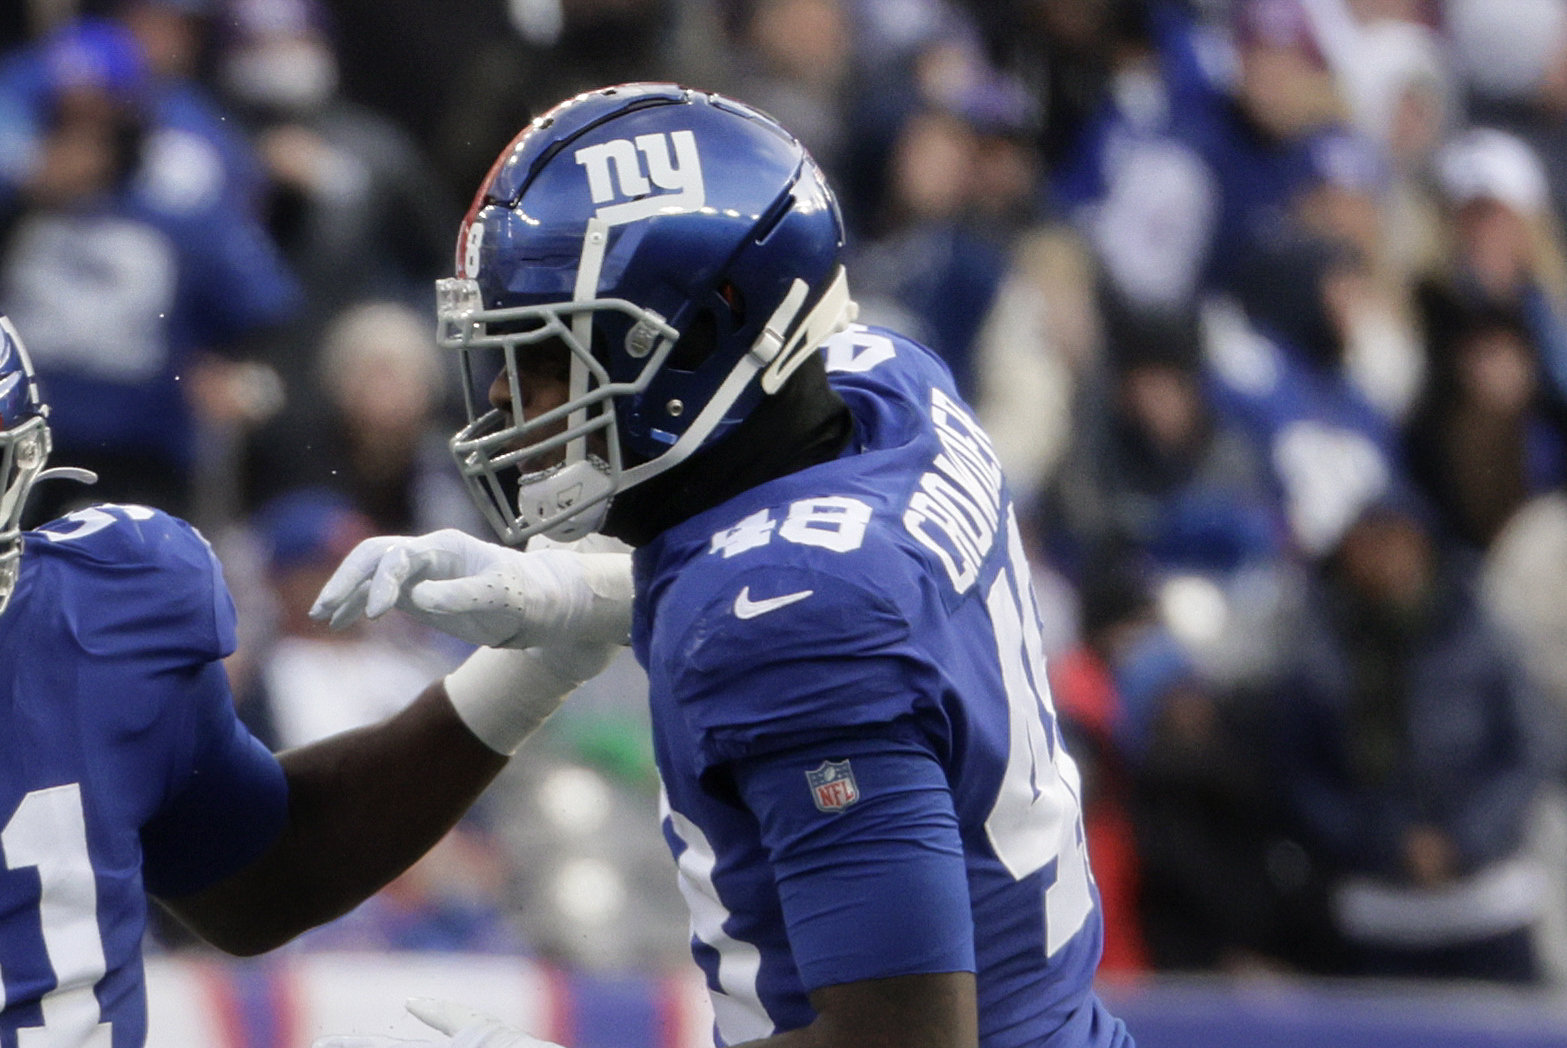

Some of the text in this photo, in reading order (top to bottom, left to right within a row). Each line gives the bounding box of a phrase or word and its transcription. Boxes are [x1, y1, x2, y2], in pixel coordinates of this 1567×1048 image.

[575, 130, 705, 227] ny
[709, 496, 872, 559] 48
[903, 387, 1003, 595] CROWDER
[818, 782, 854, 807] NFL
